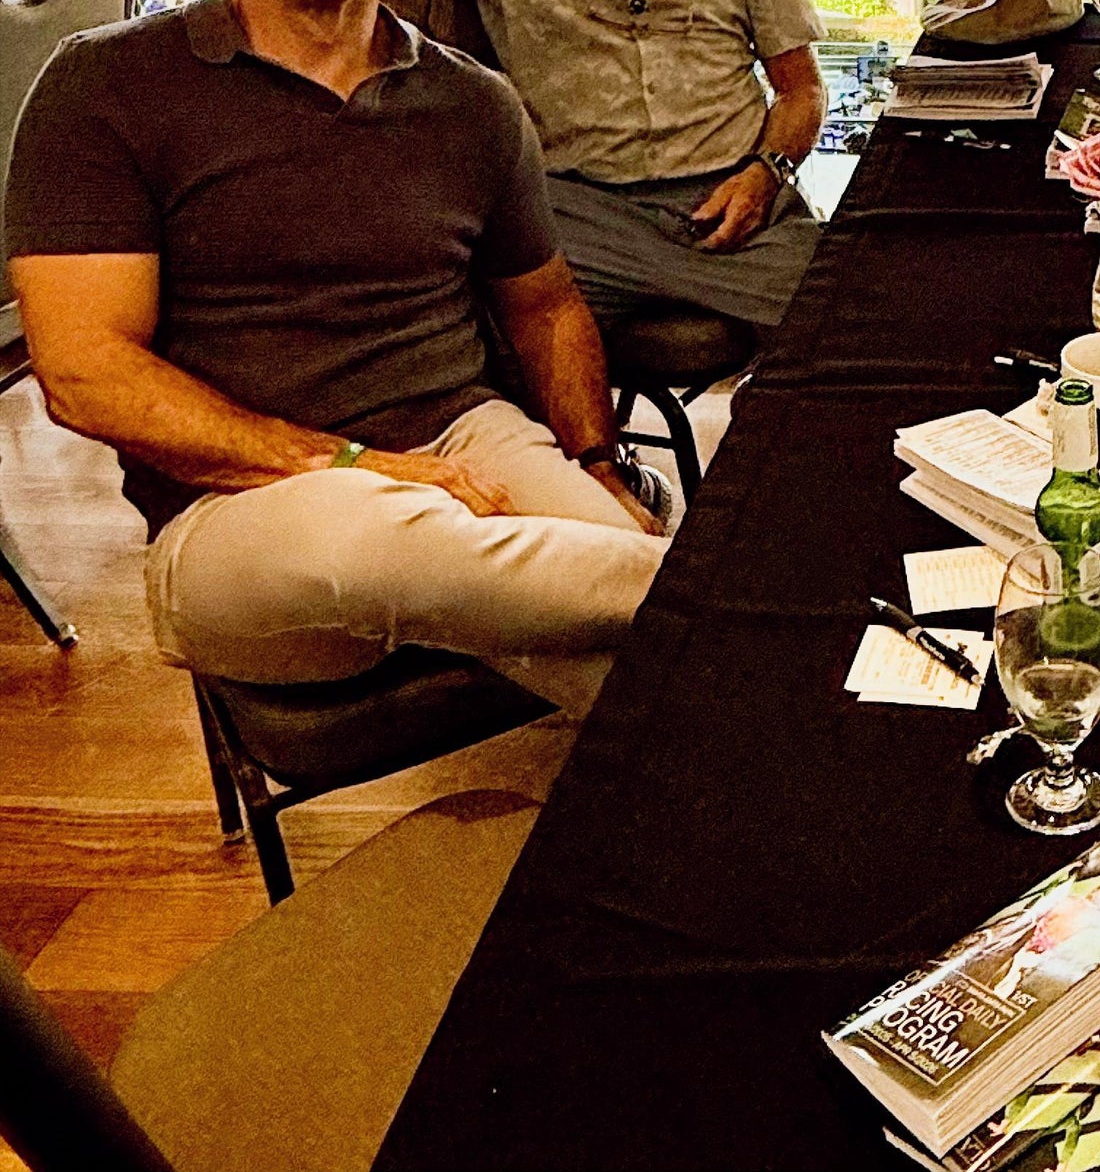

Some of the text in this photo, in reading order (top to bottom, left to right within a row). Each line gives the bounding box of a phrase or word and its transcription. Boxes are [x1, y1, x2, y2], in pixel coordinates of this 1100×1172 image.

[878, 980, 965, 1033] RCING
[959, 998, 1007, 1031] DAILY
[859, 998, 971, 1069] POGRAM
